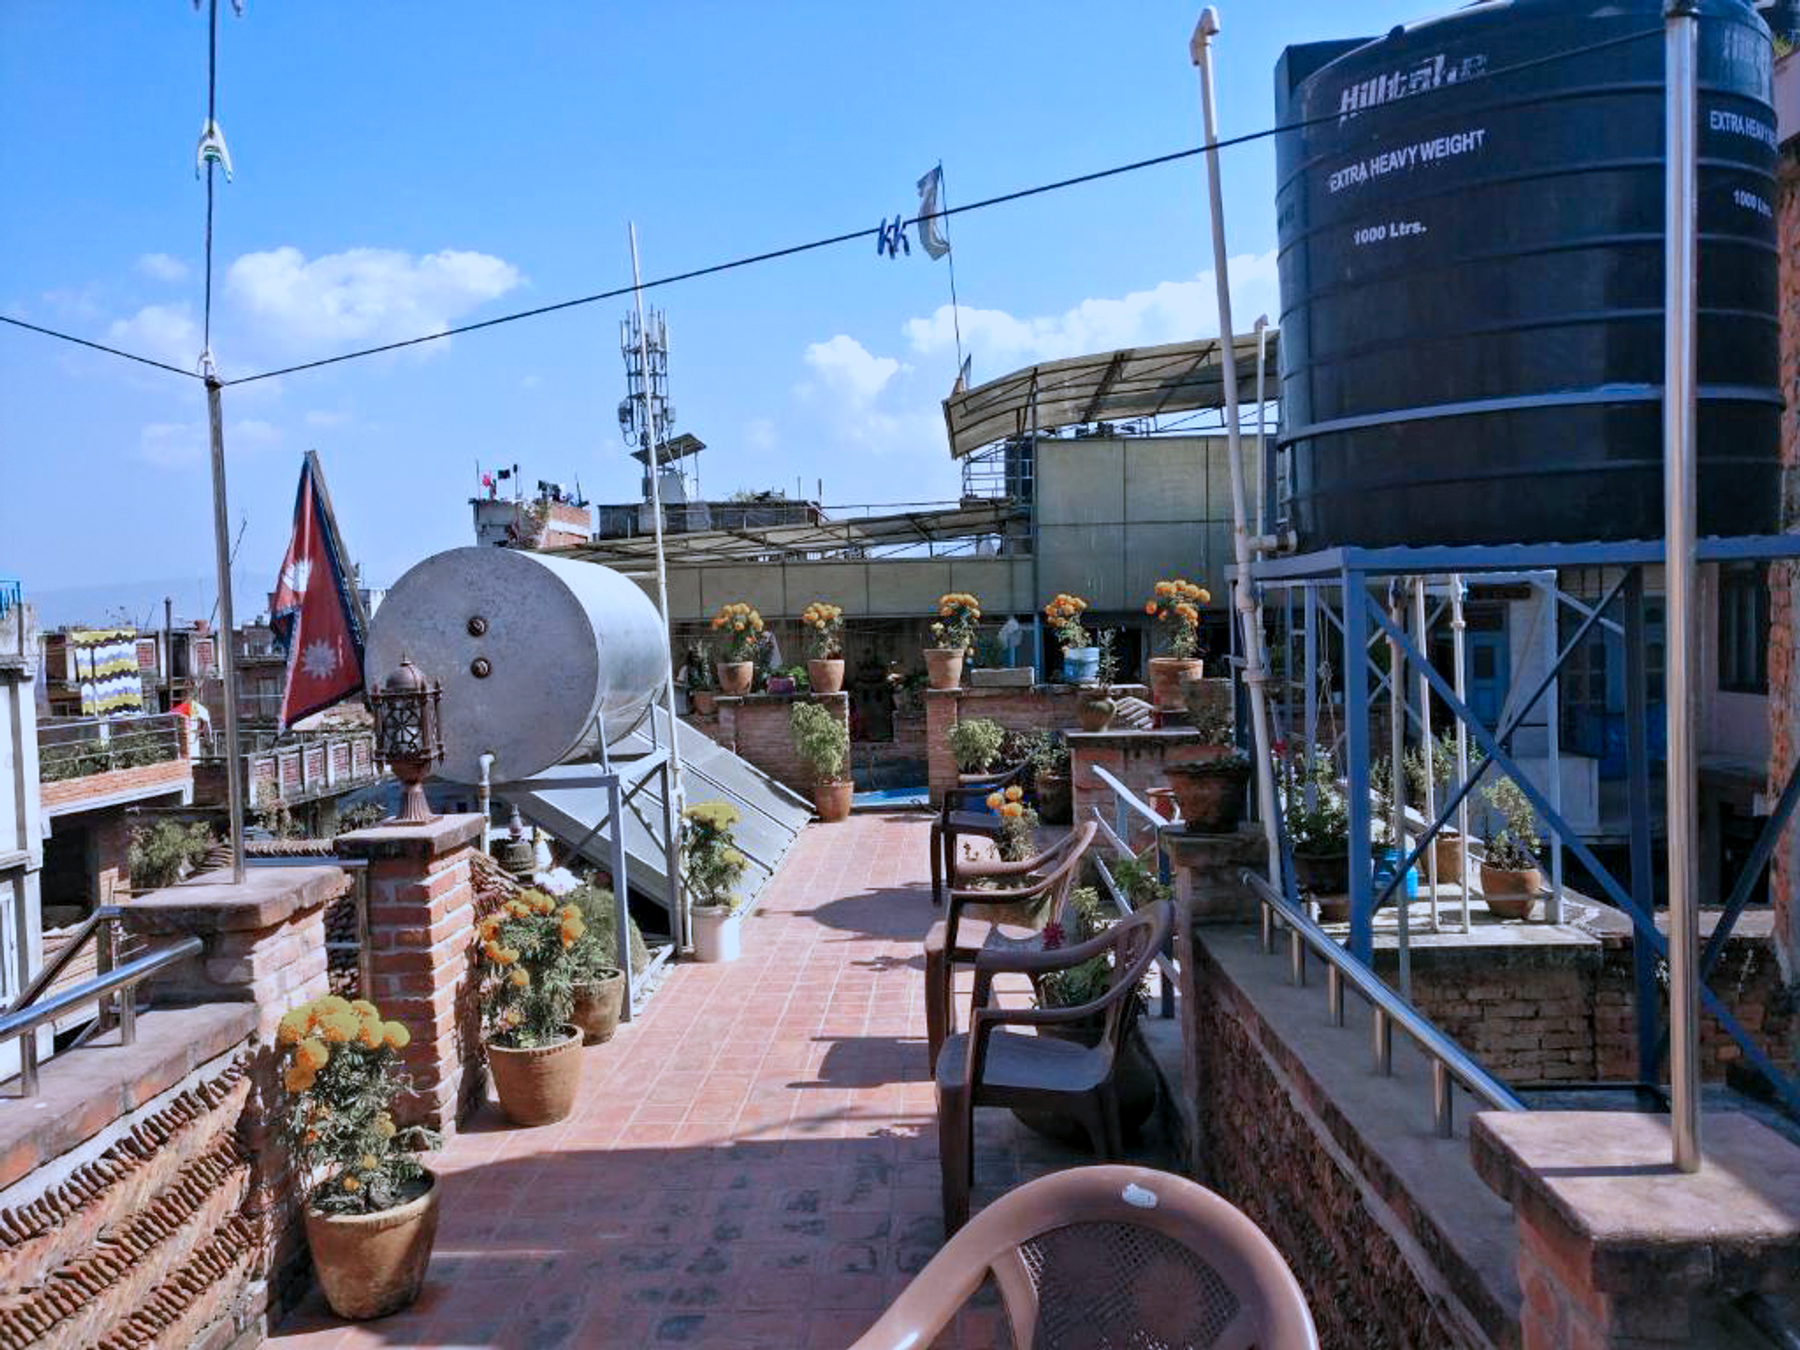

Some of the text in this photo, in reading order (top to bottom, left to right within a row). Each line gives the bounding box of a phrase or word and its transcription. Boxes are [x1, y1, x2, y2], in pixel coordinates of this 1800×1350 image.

[1710, 110, 1744, 135] EXTRA
[1330, 129, 1485, 193] EXTRA HEAVY WEIGHT
[1734, 189, 1757, 210] 1000
[1353, 222, 1427, 245] 1000 Ltrs.
